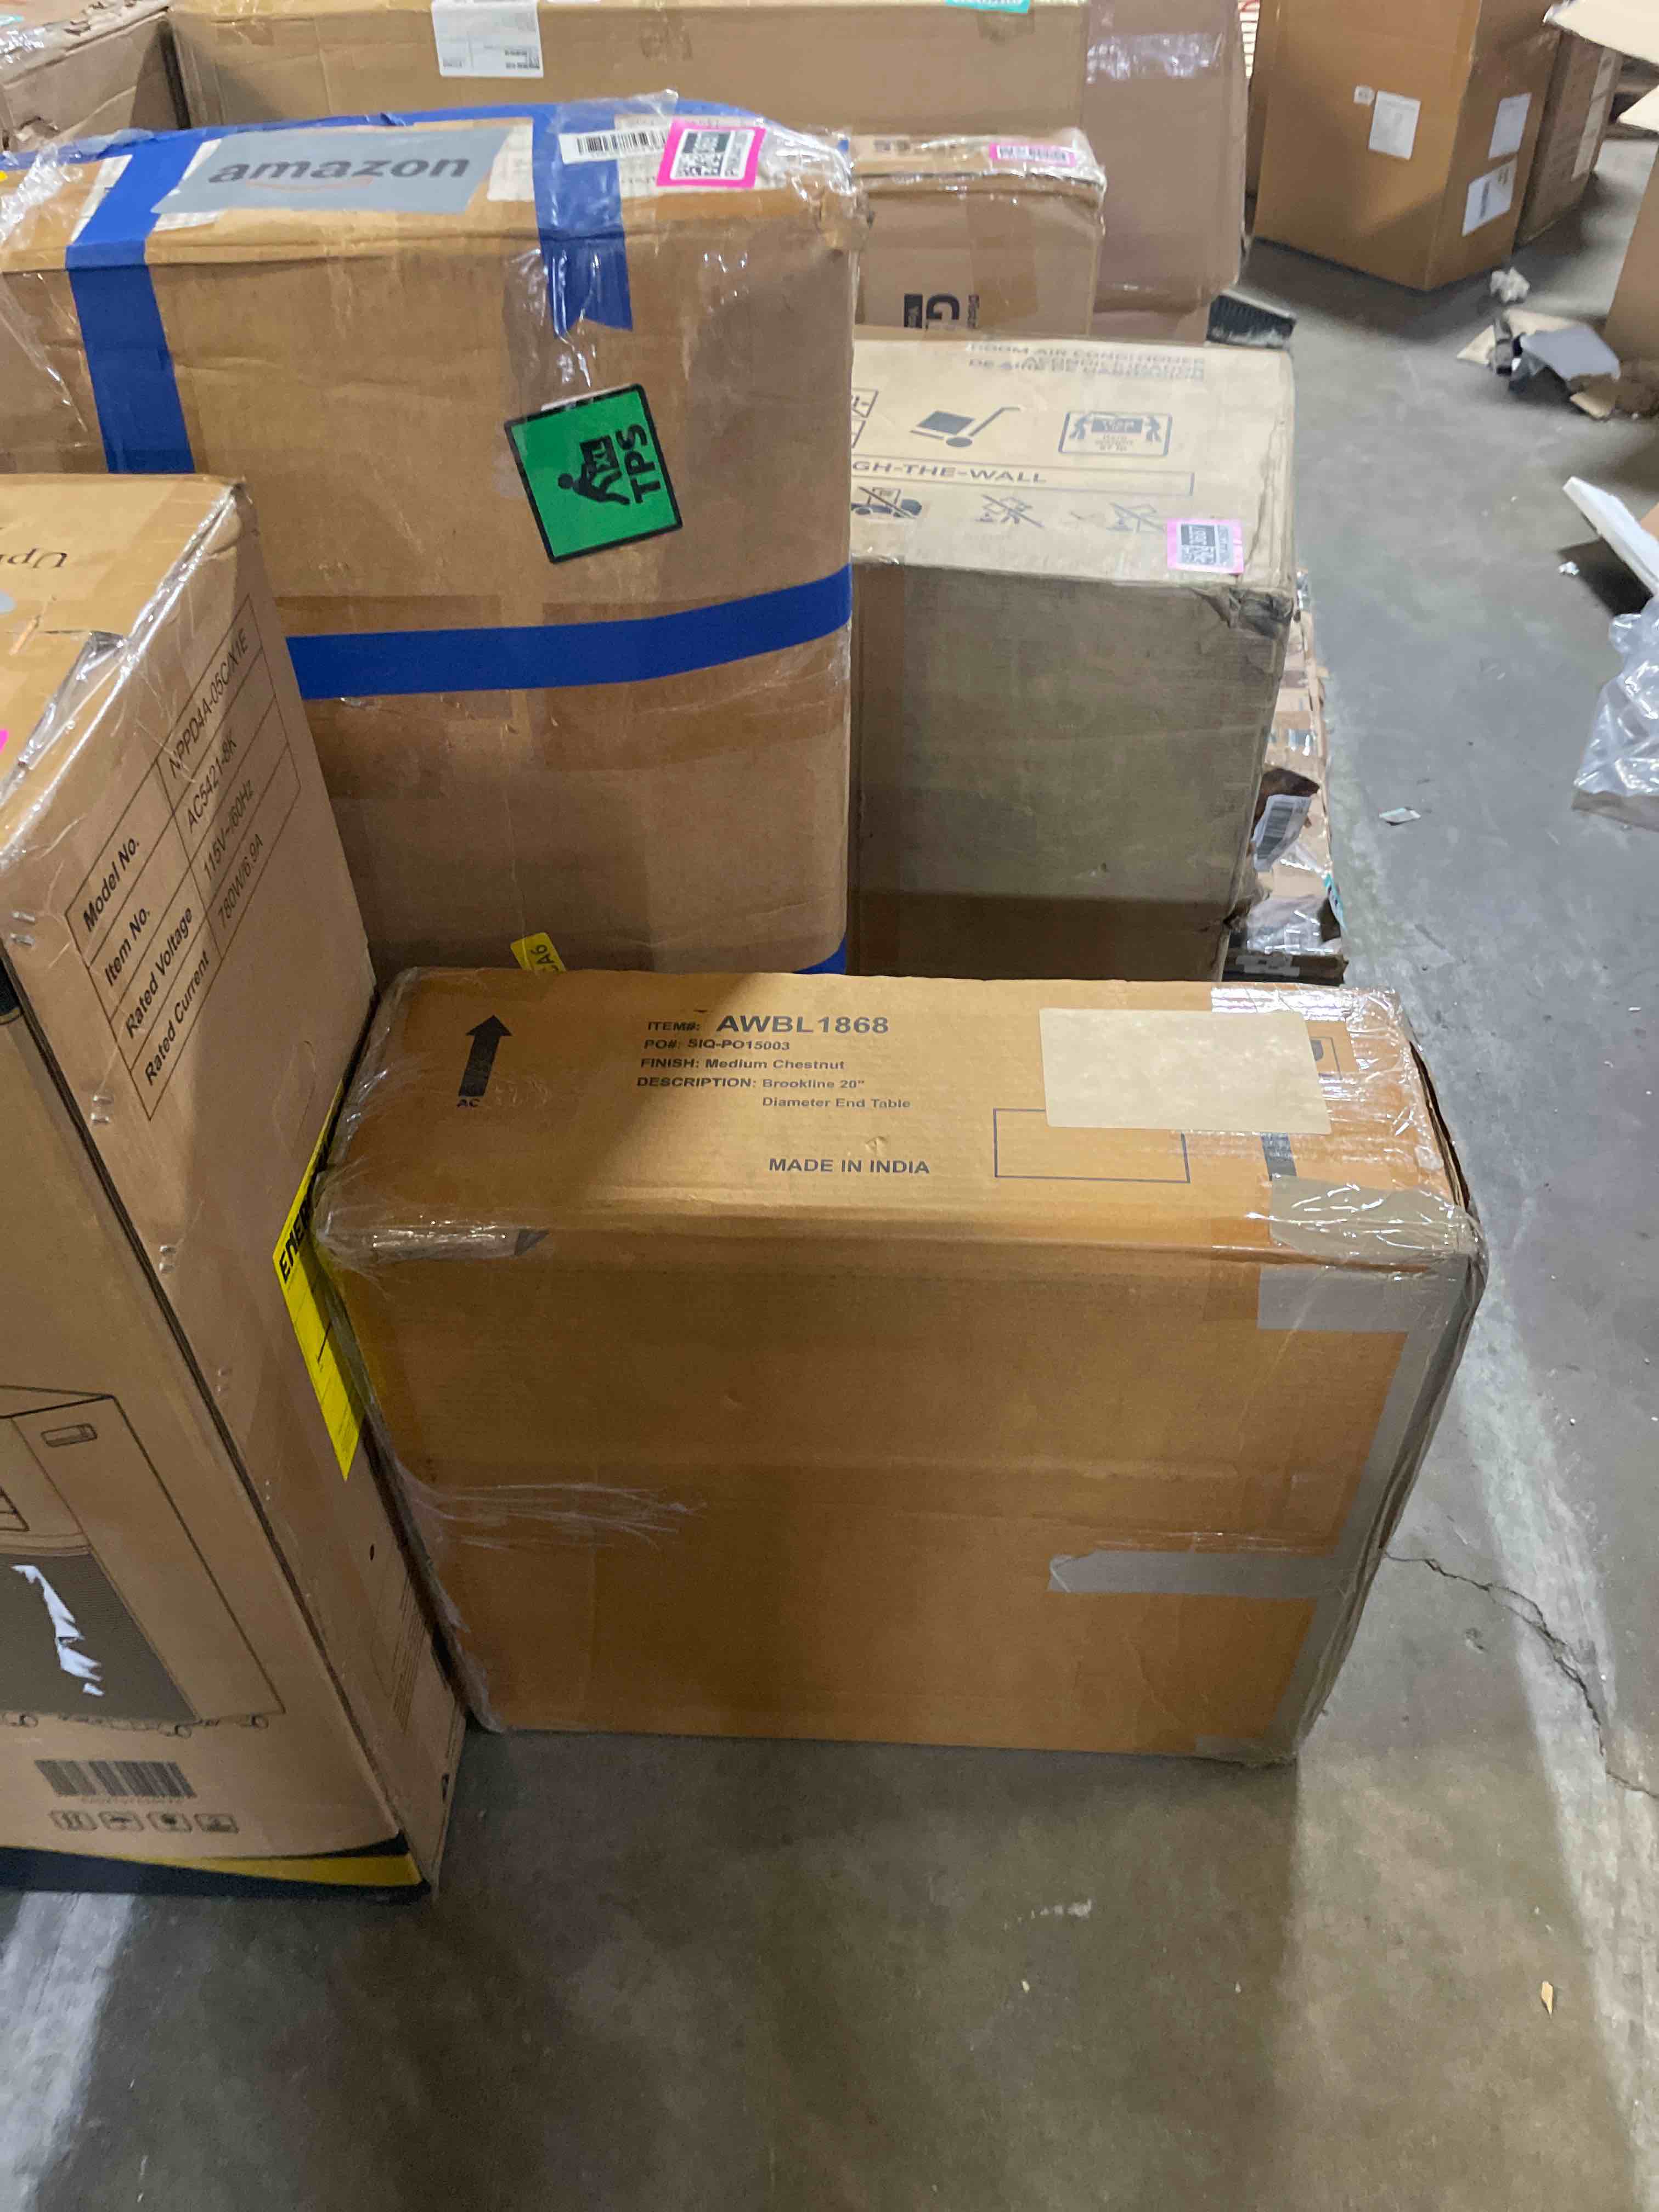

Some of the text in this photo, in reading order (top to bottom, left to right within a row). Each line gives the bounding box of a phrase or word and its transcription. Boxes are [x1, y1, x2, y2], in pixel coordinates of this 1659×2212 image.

[208, 158, 470, 183] amazon
[615, 424, 661, 503] TPS
[83, 861, 120, 932] Model
[118, 838, 139, 871] No.
[105, 939, 131, 986] Item
[129, 908, 150, 941] No.
[126, 971, 158, 1039] Rated
[155, 907, 193, 975] Voltage
[145, 1020, 176, 1086] Rated
[174, 950, 209, 1023] Current
[647, 1015, 889, 1034] ITEM#: AWBL1868
[644, 1039, 790, 1051] PO#: SIQ-PO15003
[640, 1058, 845, 1070] FINISH: Medium Chestnut
[636, 1077, 757, 1087] DESCRIPTION:
[763, 1079, 834, 1089] Brookline
[762, 1097, 911, 1108] Diameter End Table
[769, 1158, 930, 1174] MADE IN INDIA
